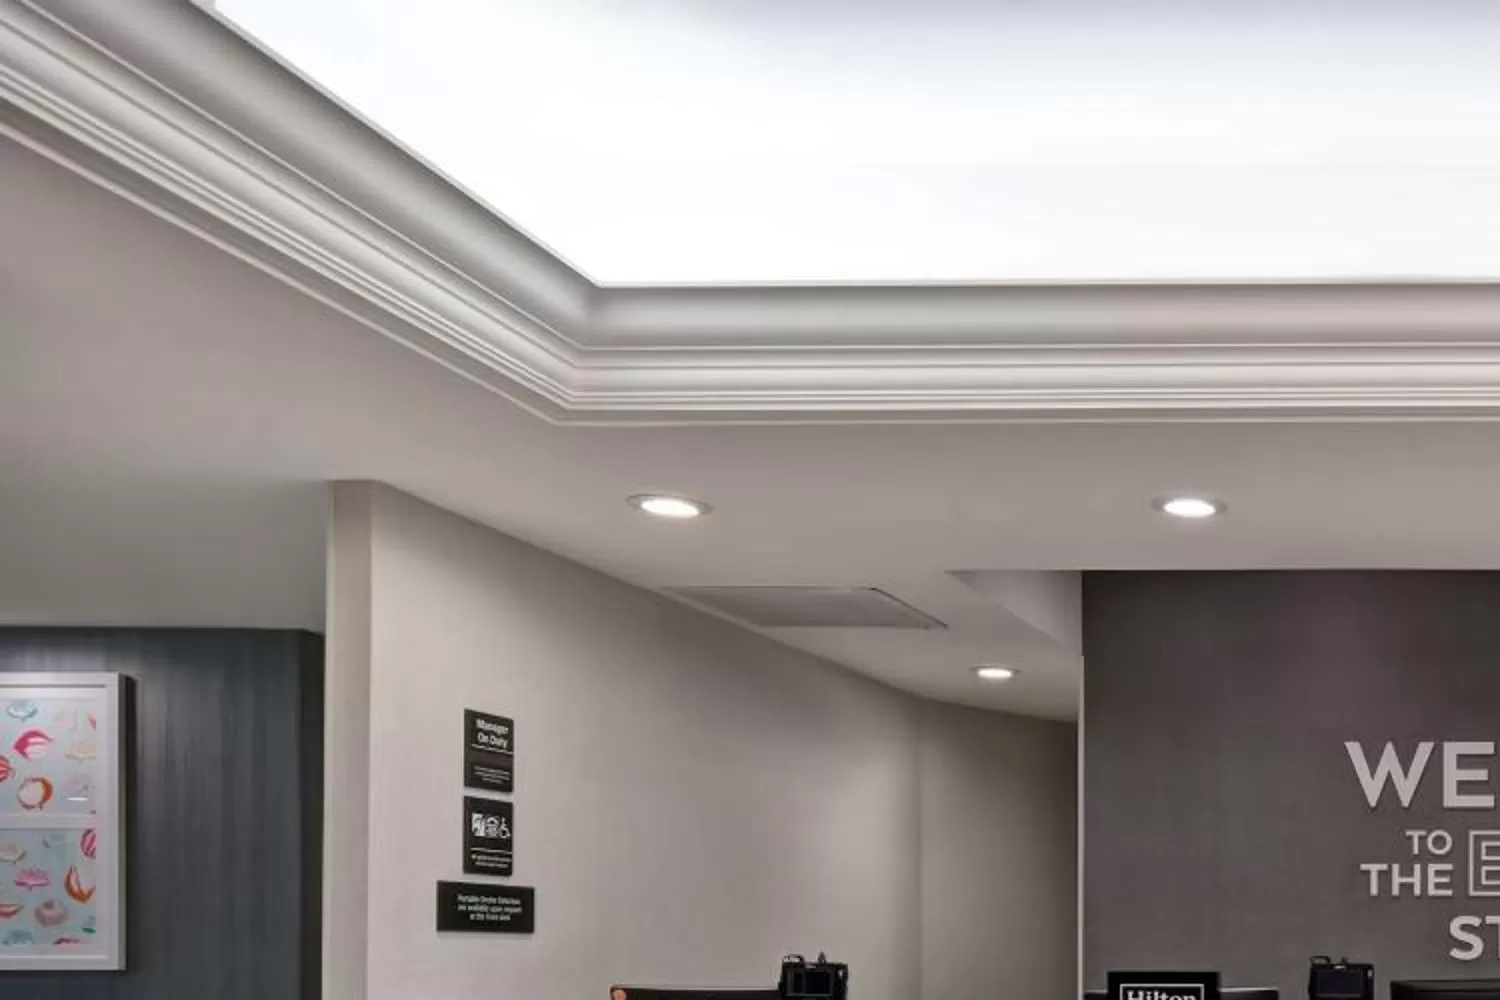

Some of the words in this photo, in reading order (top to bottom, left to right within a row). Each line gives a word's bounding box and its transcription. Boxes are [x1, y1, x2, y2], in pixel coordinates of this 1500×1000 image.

[477, 731, 489, 744] On
[1405, 830, 1453, 855] TO
[1359, 863, 1453, 896] THE
